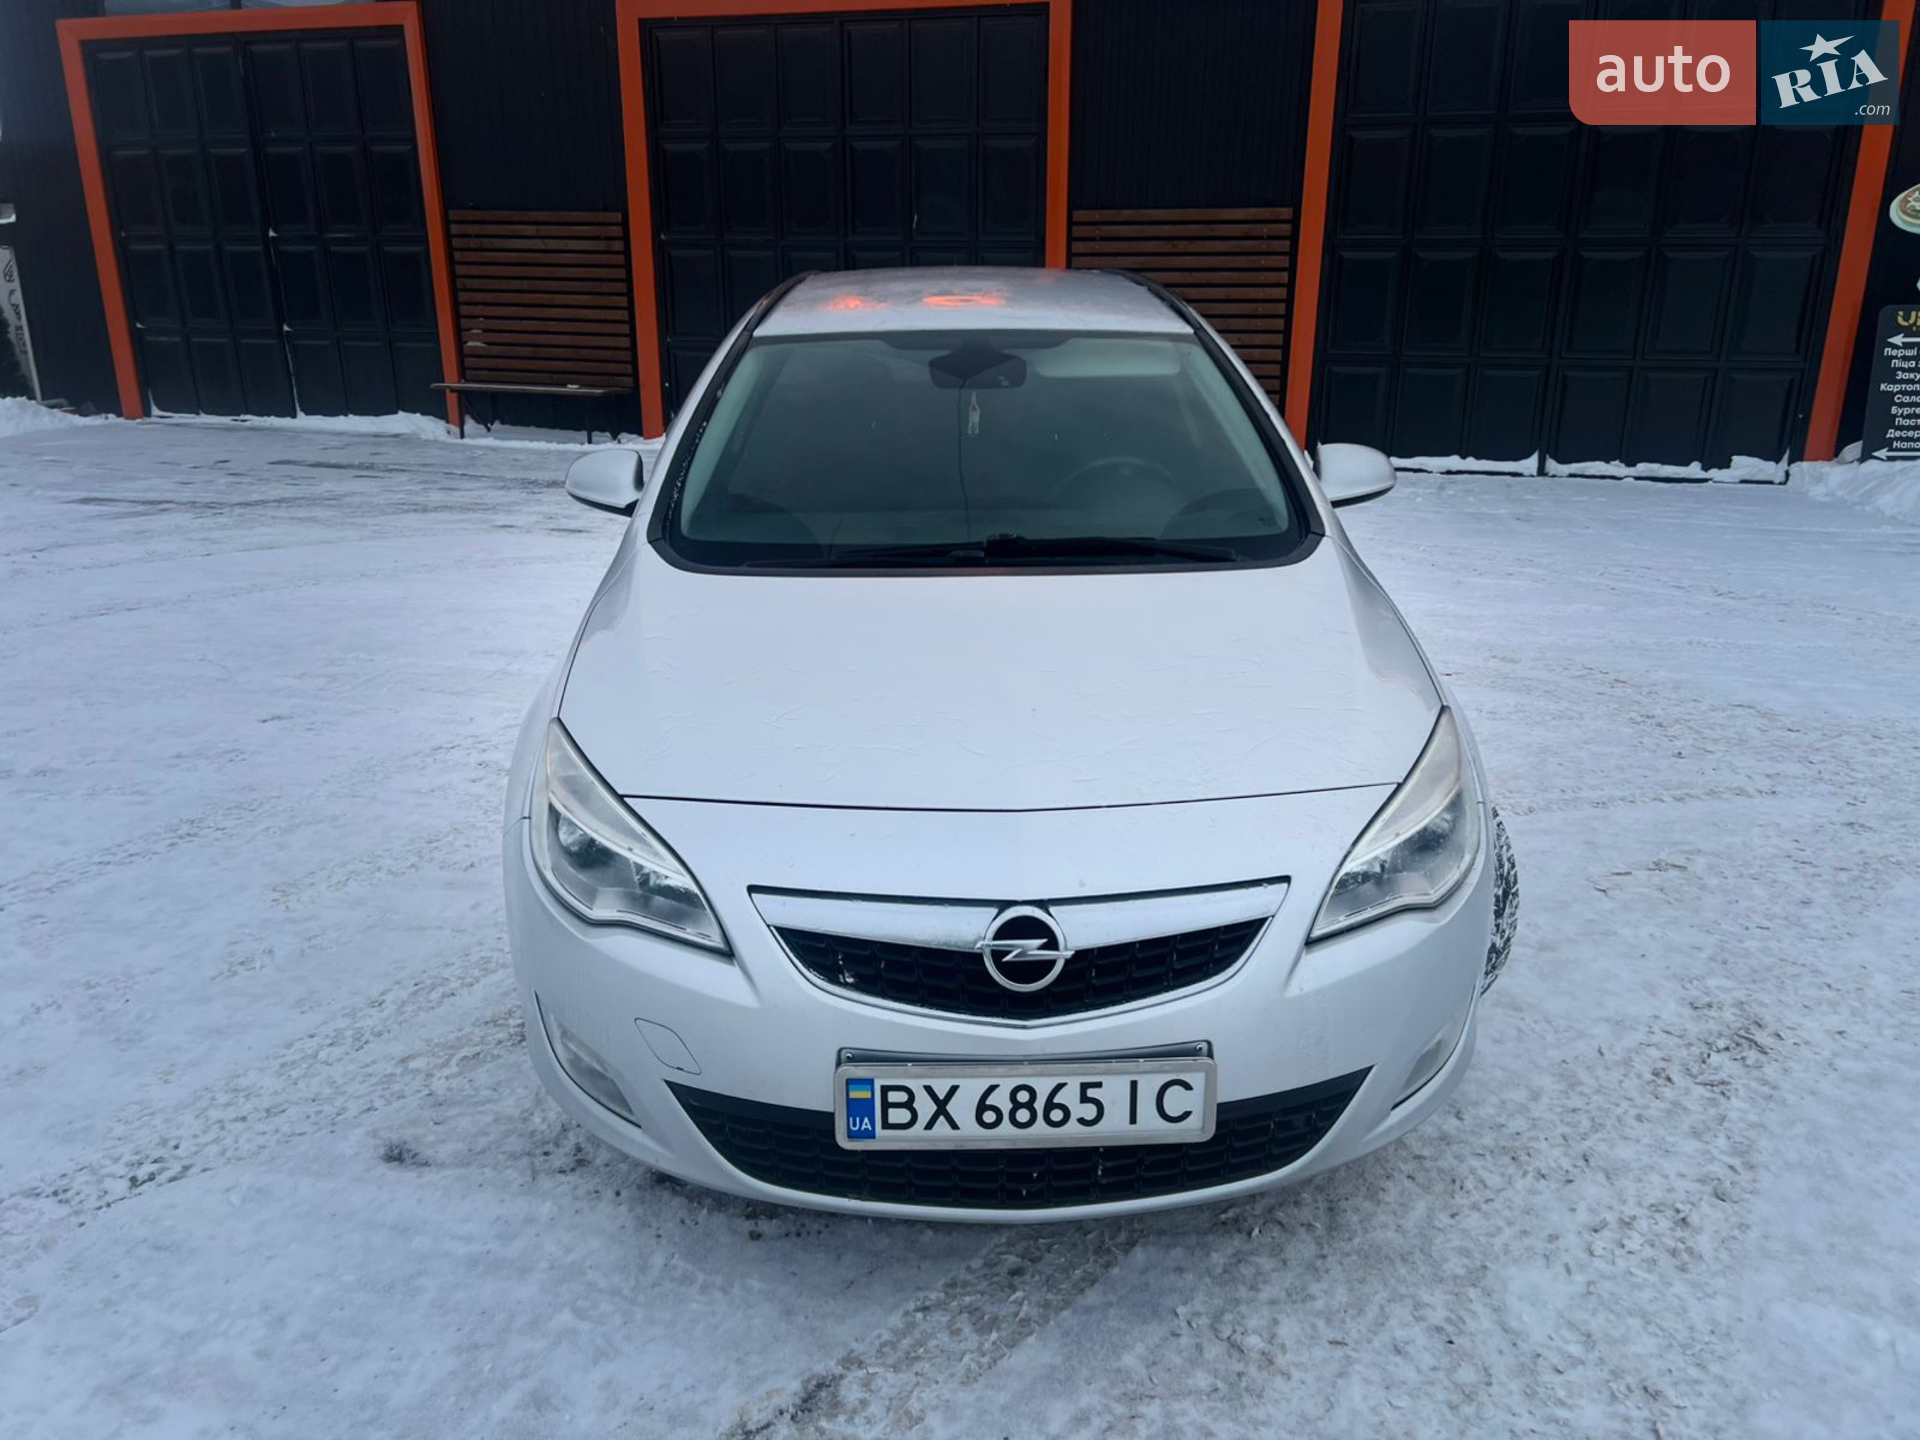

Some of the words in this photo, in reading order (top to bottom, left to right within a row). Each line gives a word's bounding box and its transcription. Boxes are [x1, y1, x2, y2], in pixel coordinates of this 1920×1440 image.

[1884, 347, 1917, 358] Перші
[1891, 359, 1916, 369] Піца
[880, 1084, 961, 1131] BX
[974, 1081, 1106, 1129] 6865
[1128, 1078, 1194, 1126] IC
[849, 1117, 872, 1132] UA
